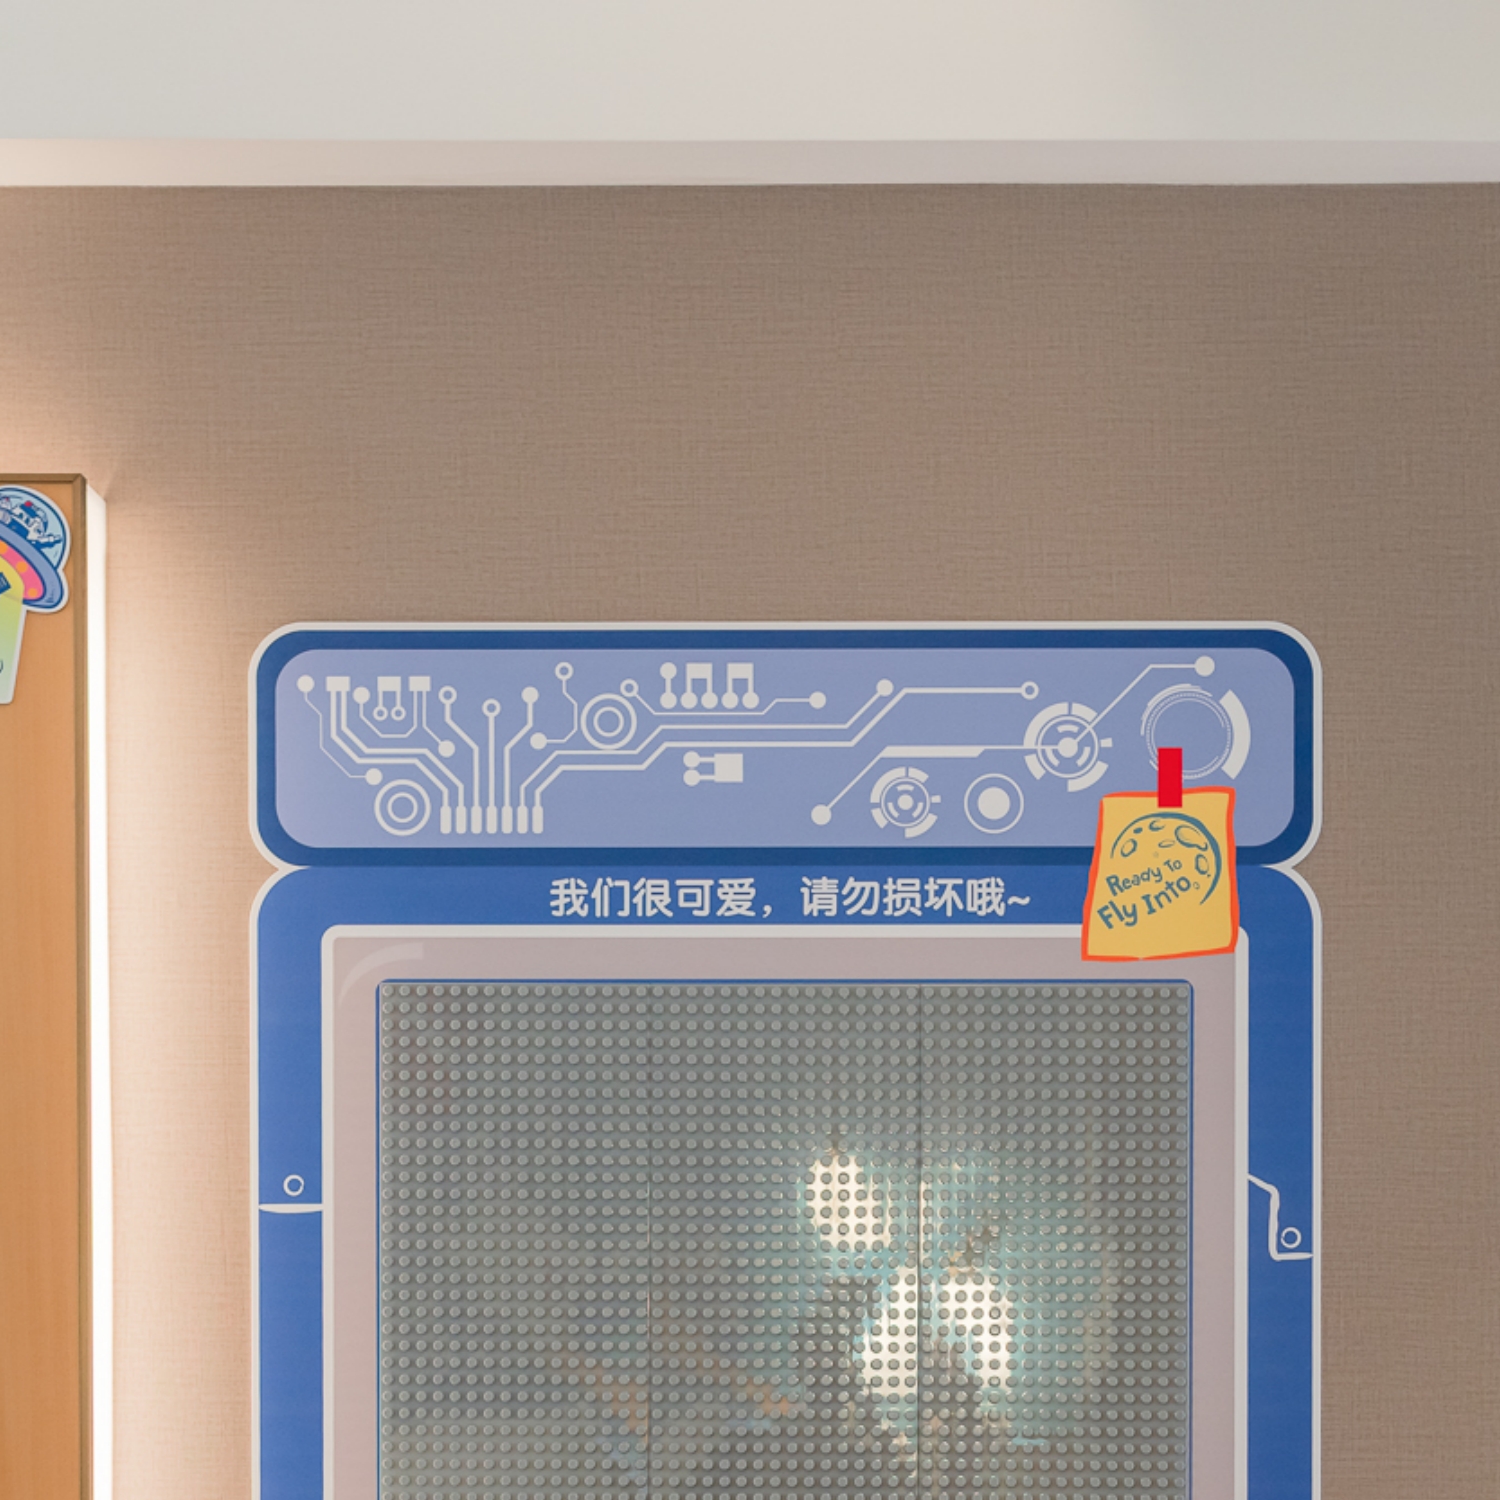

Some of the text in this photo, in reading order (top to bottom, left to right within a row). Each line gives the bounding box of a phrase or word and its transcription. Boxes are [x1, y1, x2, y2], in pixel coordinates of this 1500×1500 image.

[1105, 859, 1182, 896] Ready To
[1097, 876, 1191, 929] Fly Into
